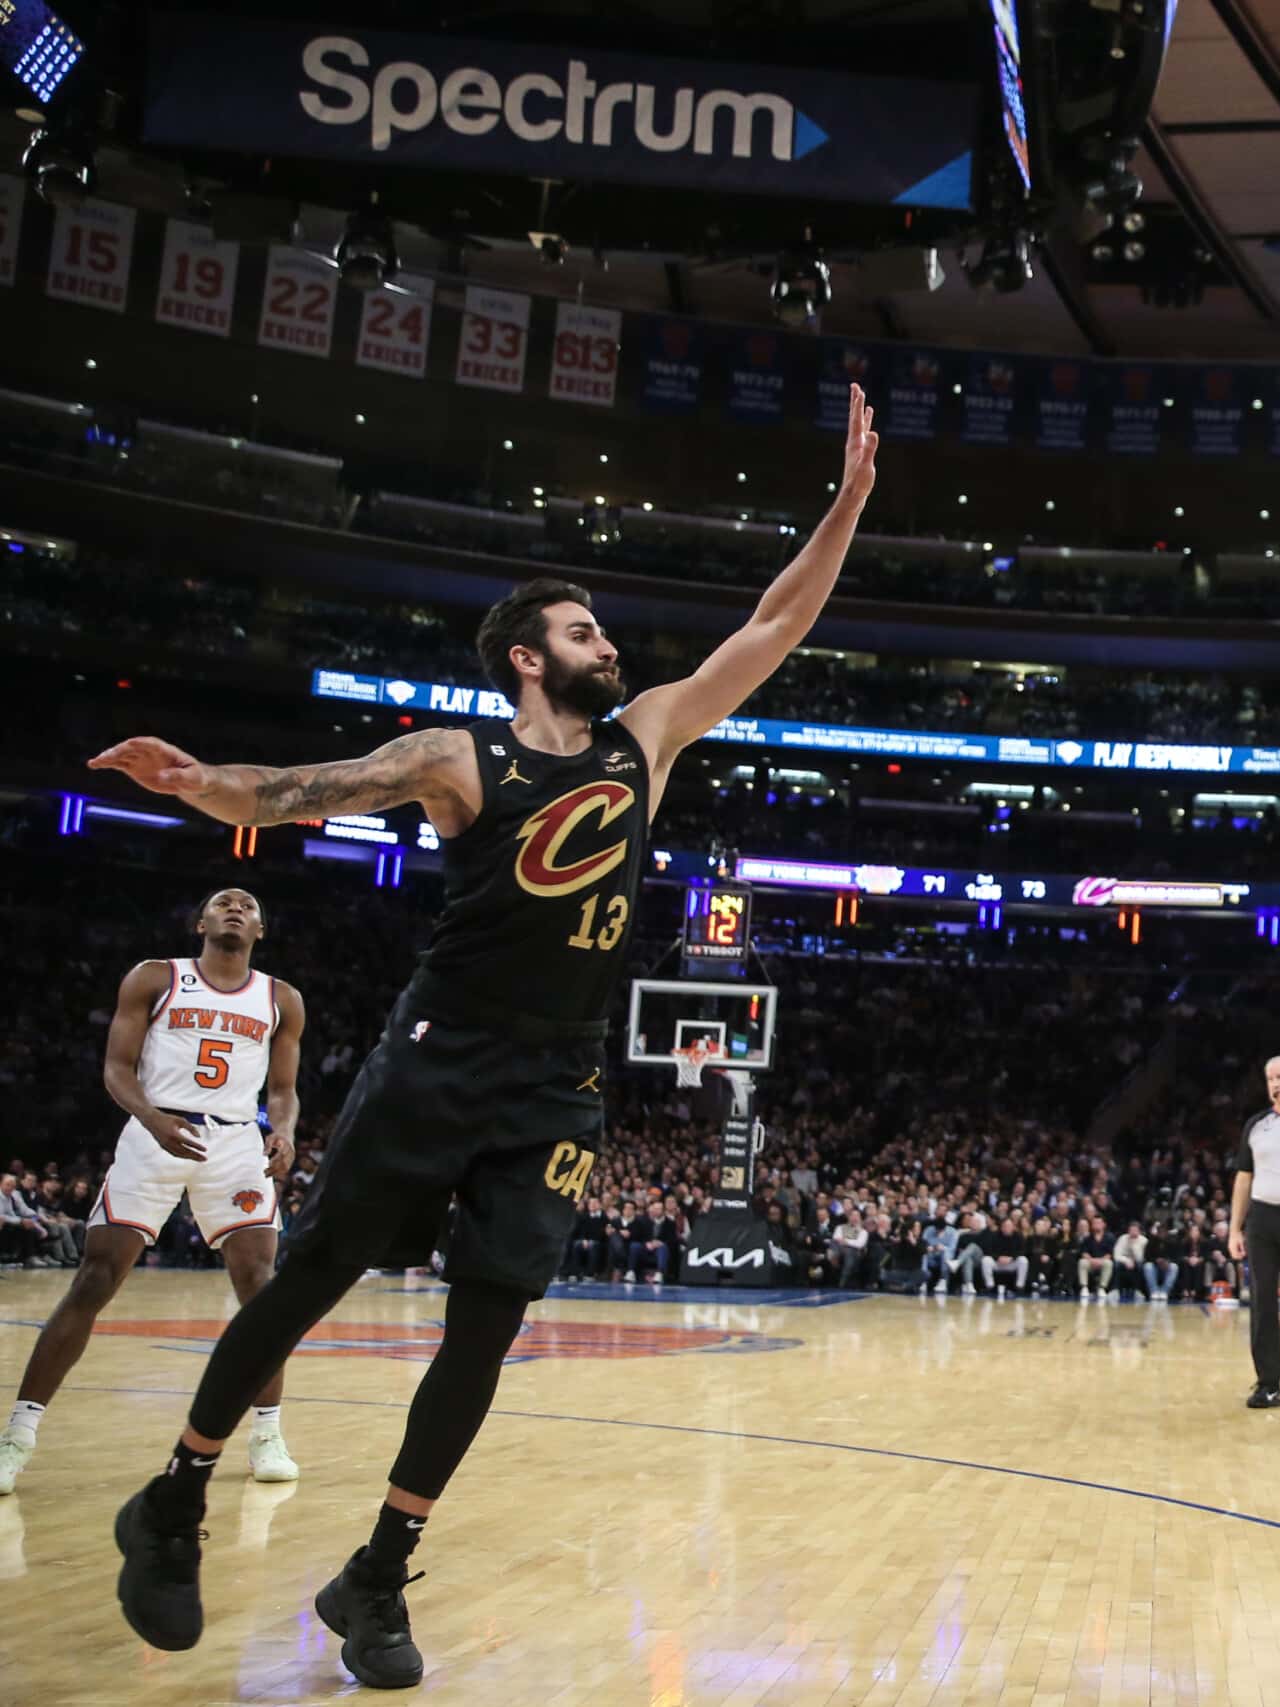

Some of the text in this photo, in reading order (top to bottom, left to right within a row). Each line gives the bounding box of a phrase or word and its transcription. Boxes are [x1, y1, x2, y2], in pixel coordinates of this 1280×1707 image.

[300, 36, 793, 161] Spectrum
[64, 224, 119, 274] 15
[52, 271, 124, 304] KNICKS
[174, 252, 225, 298] 19
[161, 296, 228, 328] KNICKS
[269, 276, 330, 324] 22
[263, 320, 328, 349] KNICKS
[367, 296, 424, 345] 24
[466, 317, 522, 359] 33
[556, 330, 617, 374] 613
[362, 340, 425, 369] KNICKS
[460, 359, 519, 385] KNICKS
[554, 374, 612, 399] KNICKS
[430, 684, 475, 714] PLAY
[490, 745, 507, 756] 6
[1093, 742, 1132, 767] PLAY
[515, 781, 636, 897] C
[923, 875, 945, 893] 71
[1022, 880, 1046, 899] 73
[567, 893, 629, 951] 13
[708, 913, 737, 945] 12
[703, 946, 744, 957] TISSOT
[167, 1007, 269, 1044] NEW YORK
[194, 1038, 233, 1090] 5
